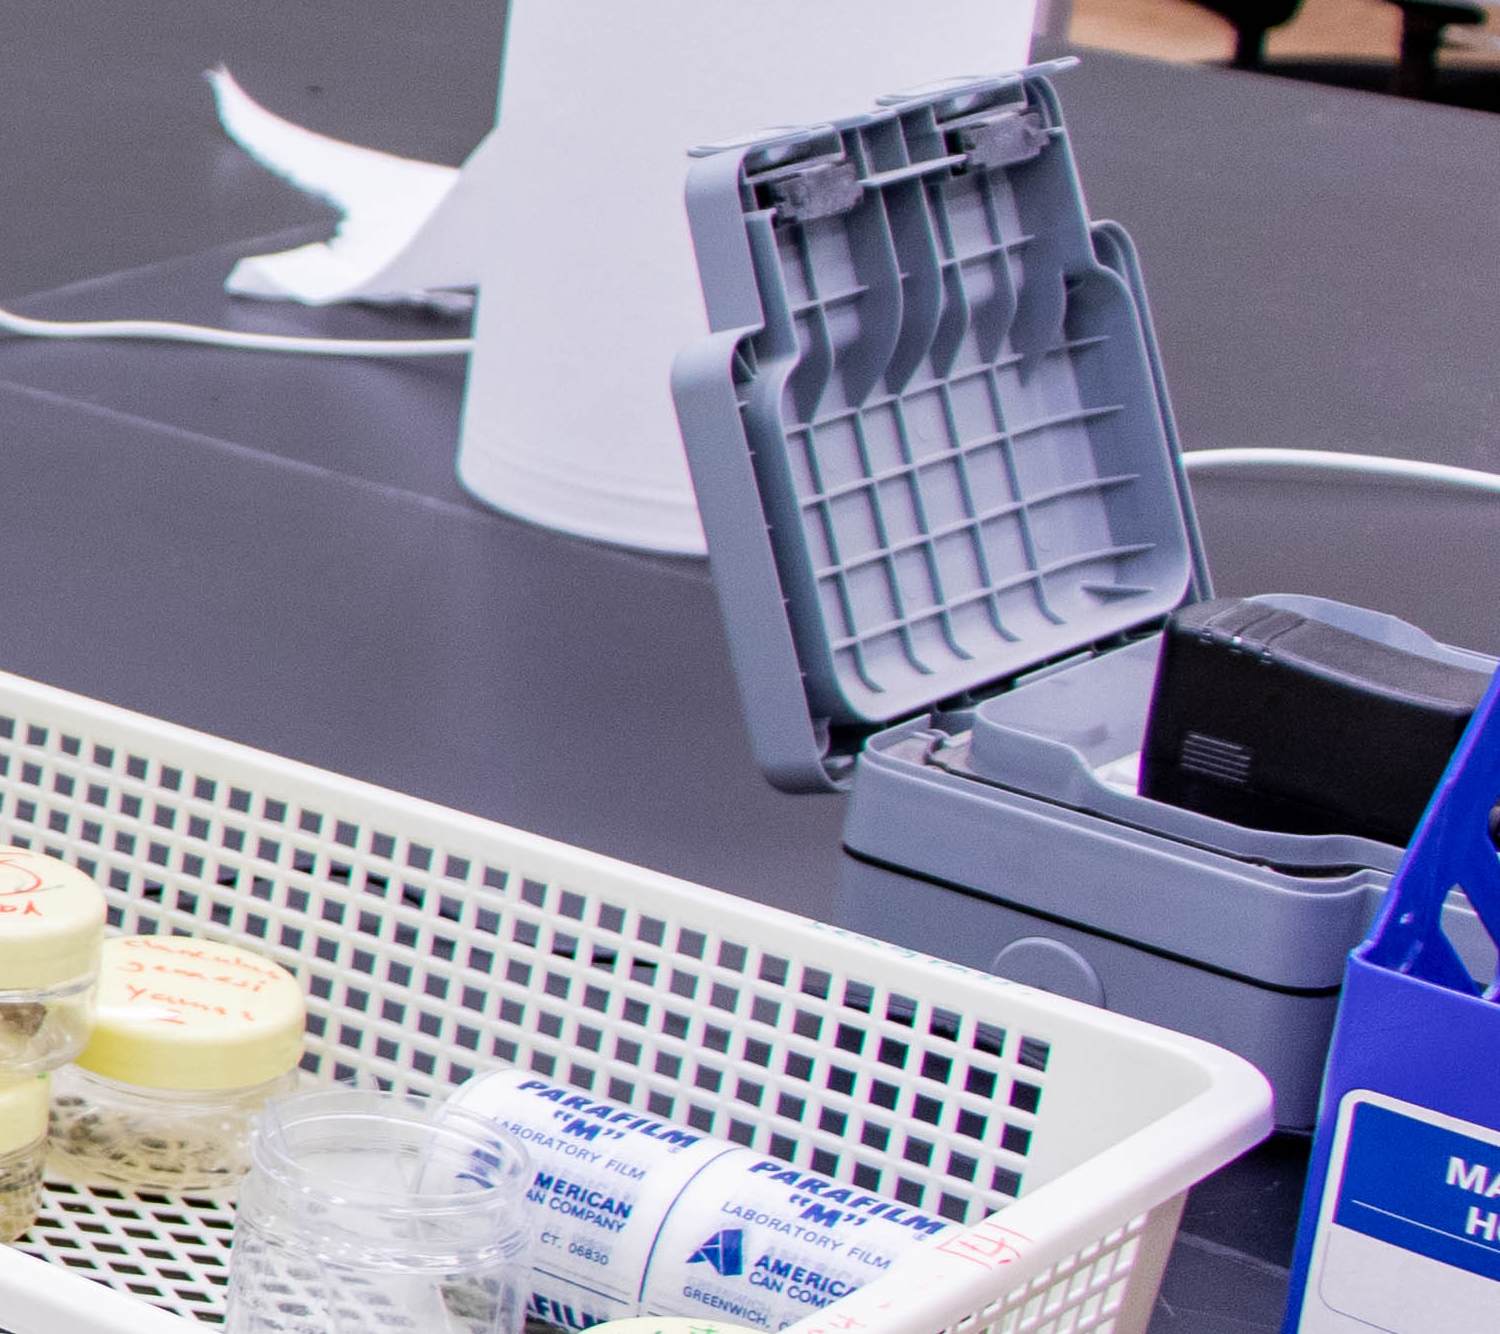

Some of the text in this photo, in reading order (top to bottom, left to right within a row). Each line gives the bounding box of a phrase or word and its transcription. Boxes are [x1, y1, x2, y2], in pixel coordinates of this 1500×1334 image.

[517, 1080, 701, 1150] PARAFILM
[604, 1158, 648, 1181] FILM
[549, 1197, 628, 1235] COMPANY
[748, 1161, 948, 1236] PARAFILM
[567, 1242, 610, 1267] 06830
[720, 1200, 844, 1253] LABORATORY
[846, 1241, 892, 1271] FILM
[749, 1270, 783, 1294] CAN
